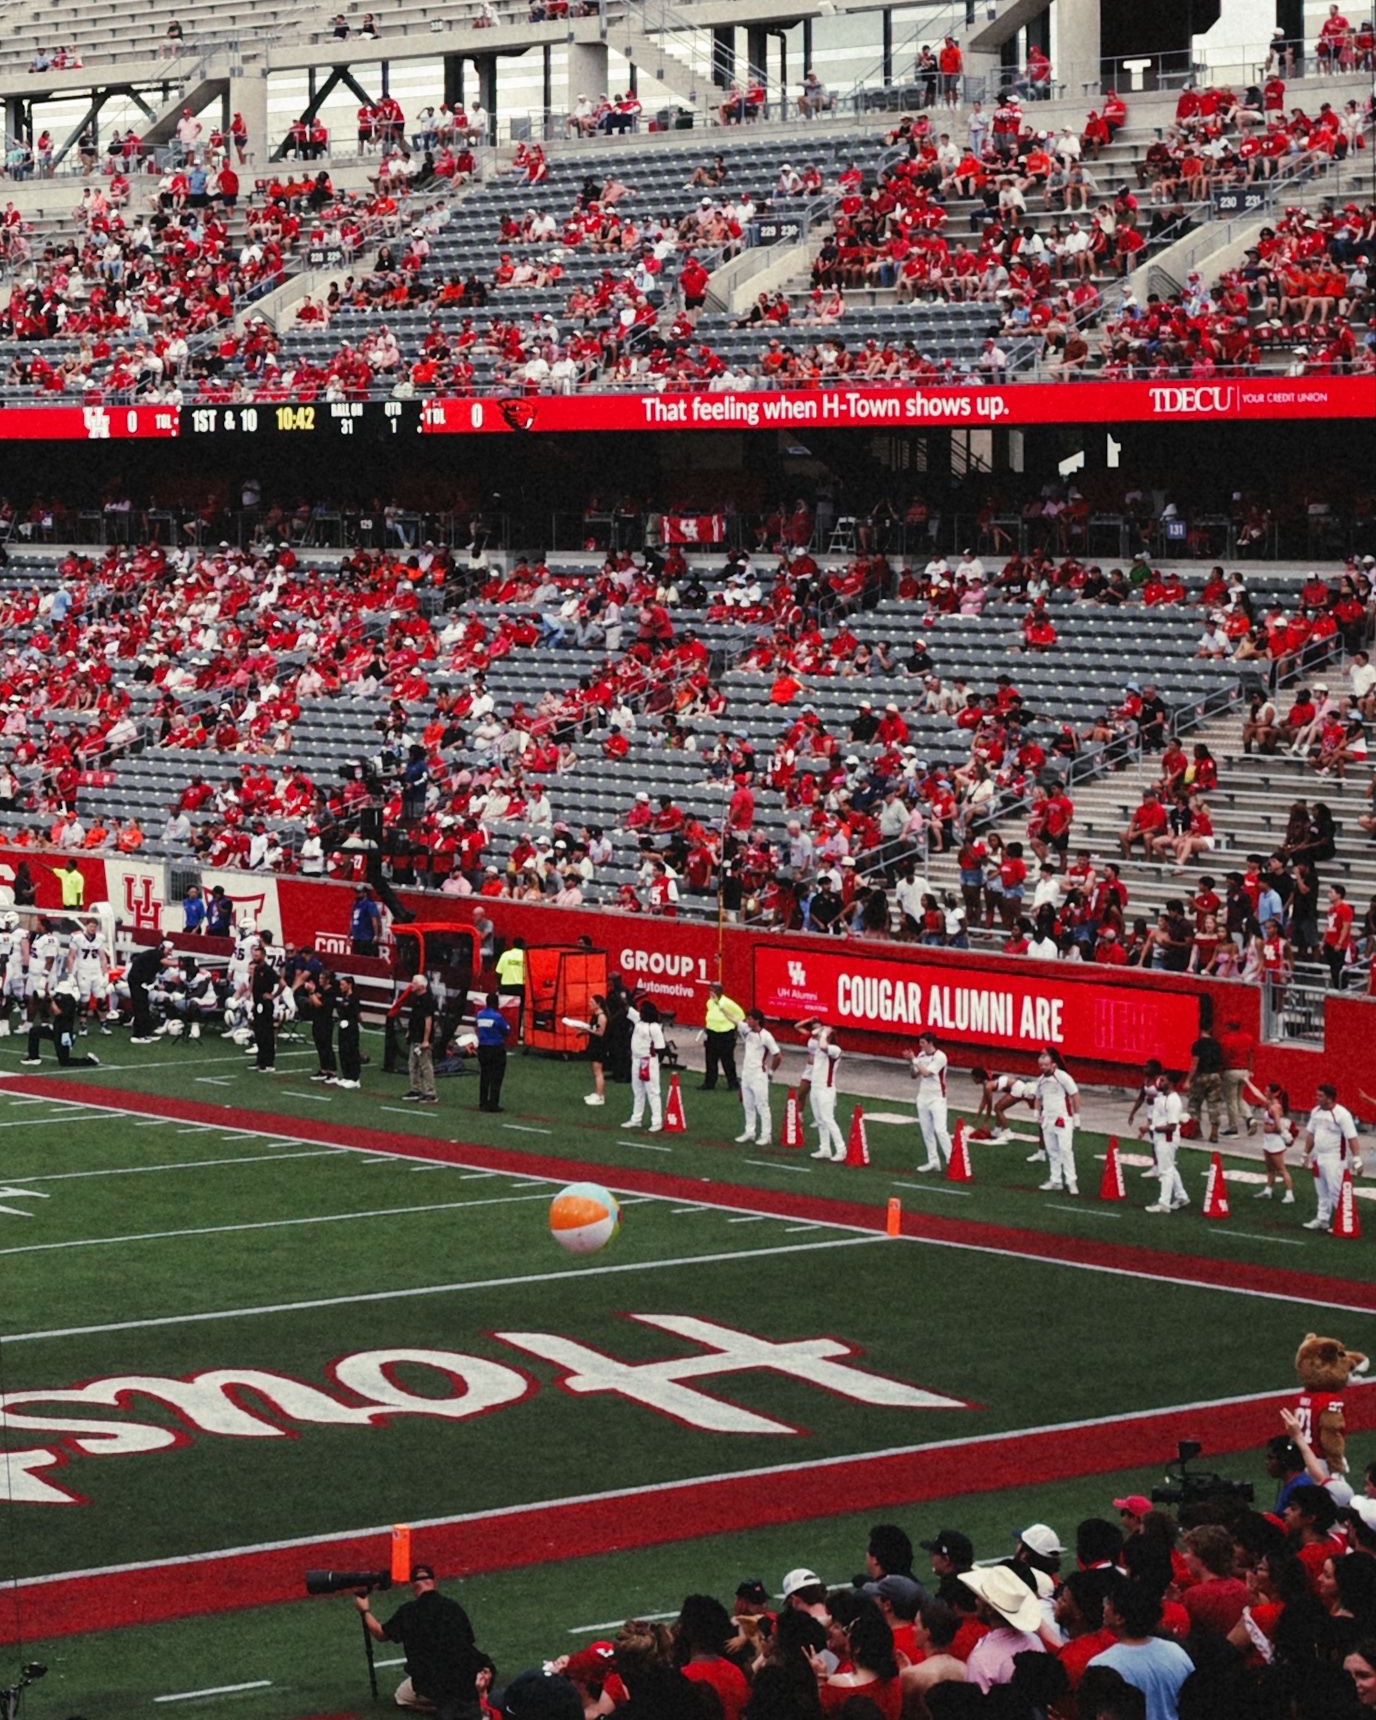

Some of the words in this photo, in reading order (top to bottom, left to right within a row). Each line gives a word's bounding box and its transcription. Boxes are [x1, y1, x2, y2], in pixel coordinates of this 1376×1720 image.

[641, 397, 687, 423] That
[691, 395, 759, 426] feeling
[763, 395, 818, 420] when
[822, 393, 901, 419] H-Town
[905, 391, 971, 417] shows
[977, 397, 1010, 421] up.
[1149, 387, 1235, 412] TDECU
[1242, 394, 1265, 404] YOUR
[1266, 393, 1294, 404] CREDIT
[1297, 392, 1327, 403] UNION
[192, 410, 217, 432] 1ST
[223, 411, 236, 431] &
[239, 409, 257, 432] 10
[275, 407, 315, 431] 10:42
[620, 948, 694, 979] GROUP
[635, 978, 694, 998] Automotive
[838, 973, 922, 1024] COUGAR
[927, 984, 1013, 1037] ALUMNI
[1020, 994, 1065, 1043] ARE
